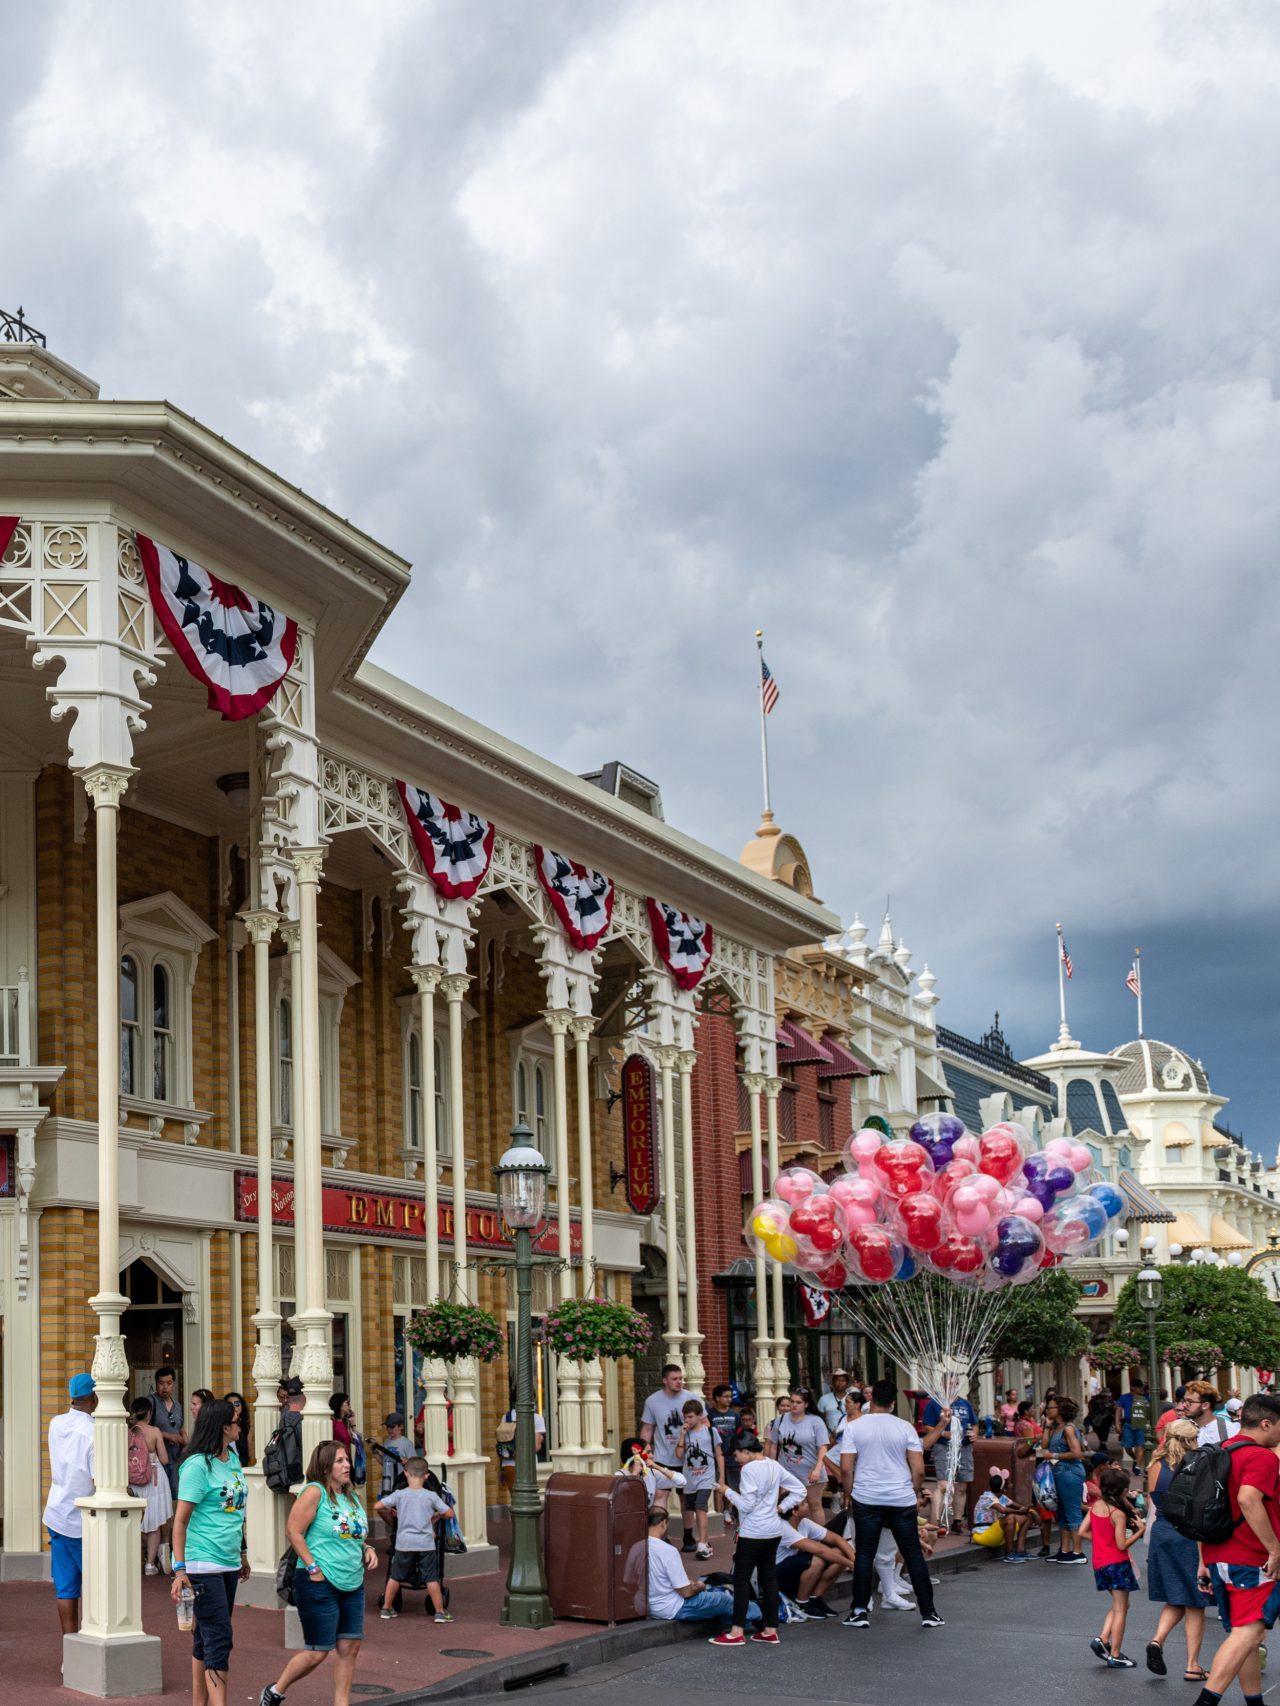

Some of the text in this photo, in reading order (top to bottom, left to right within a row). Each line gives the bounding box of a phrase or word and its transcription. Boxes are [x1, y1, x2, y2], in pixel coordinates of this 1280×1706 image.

[629, 1071, 650, 1197] EMPORIUM
[243, 1190, 258, 1207] Dry
[274, 1190, 295, 1213] Notion
[346, 1194, 518, 1242] EMPRIUM
